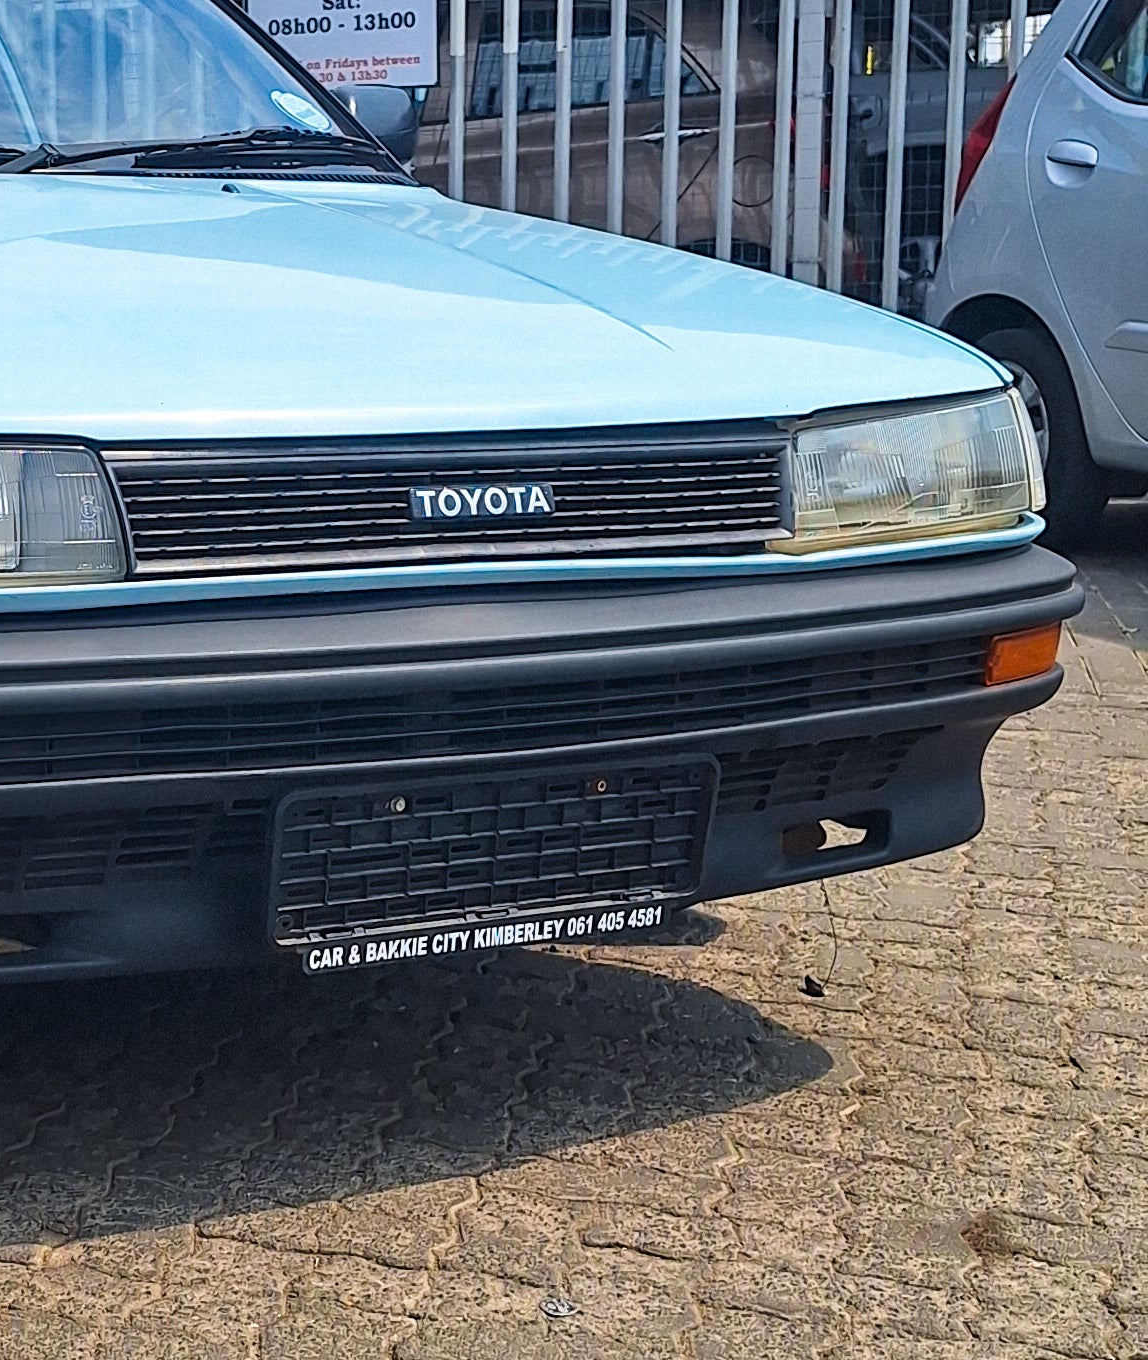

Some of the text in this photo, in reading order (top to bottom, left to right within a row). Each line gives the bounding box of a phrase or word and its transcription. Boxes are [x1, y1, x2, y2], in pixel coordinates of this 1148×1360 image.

[268, 16, 331, 36] 08h00
[353, 11, 416, 31] 13h00
[325, 57, 369, 70] Fridays
[372, 56, 421, 67] between
[351, 69, 388, 81] 13h30
[415, 486, 551, 518] TOYOTA
[308, 906, 663, 970] CAR & BAKKIE CITY KIMBERLEY 061 405 4581
